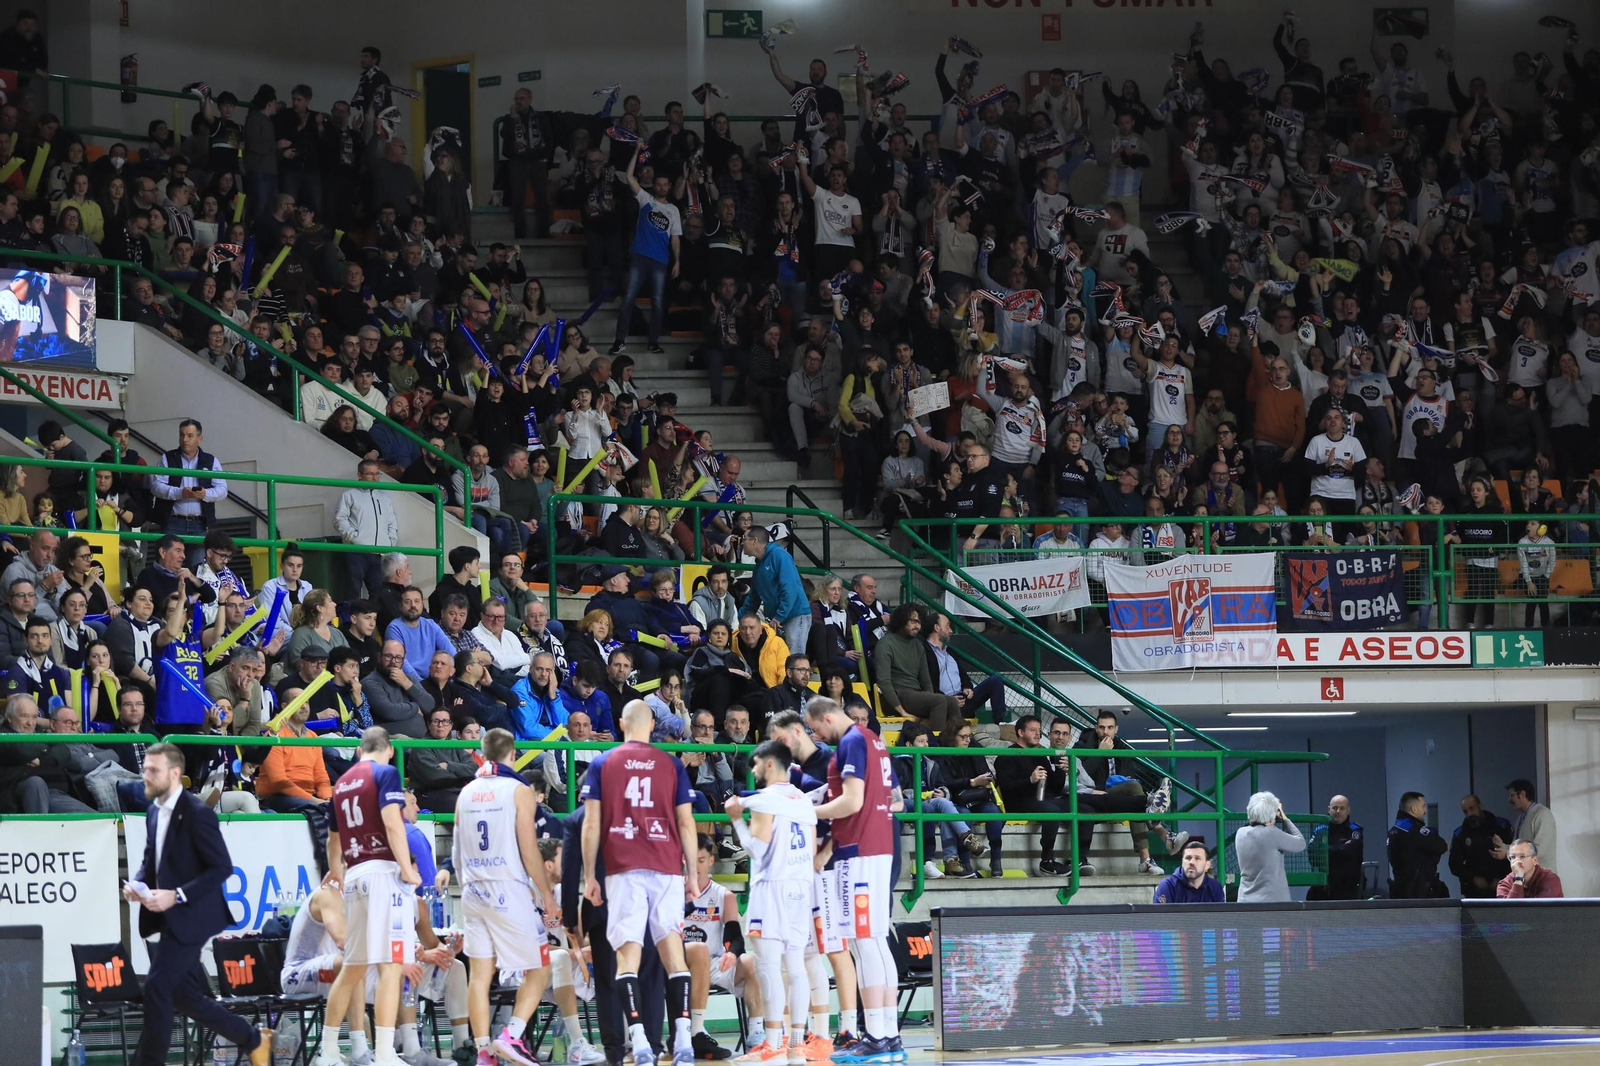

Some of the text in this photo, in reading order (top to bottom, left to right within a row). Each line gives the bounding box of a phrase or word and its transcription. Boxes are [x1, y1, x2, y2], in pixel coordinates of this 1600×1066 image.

[0, 373, 113, 402] ERXENCIA
[1146, 562, 1232, 578] XUVENTUDE
[1014, 589, 1066, 601] OBRADOIRISTA
[1340, 592, 1401, 621] OBRA
[1144, 642, 1245, 657] OBRADOIRISTA
[1305, 638, 1320, 662] E
[1338, 636, 1465, 662] ASEOS
[624, 776, 654, 807] 41
[341, 796, 364, 829] 16
[476, 820, 489, 851] 3
[0, 852, 88, 875] EPORTE
[392, 893, 402, 907] 16
[84, 956, 125, 993] spit
[223, 954, 256, 989] spit
